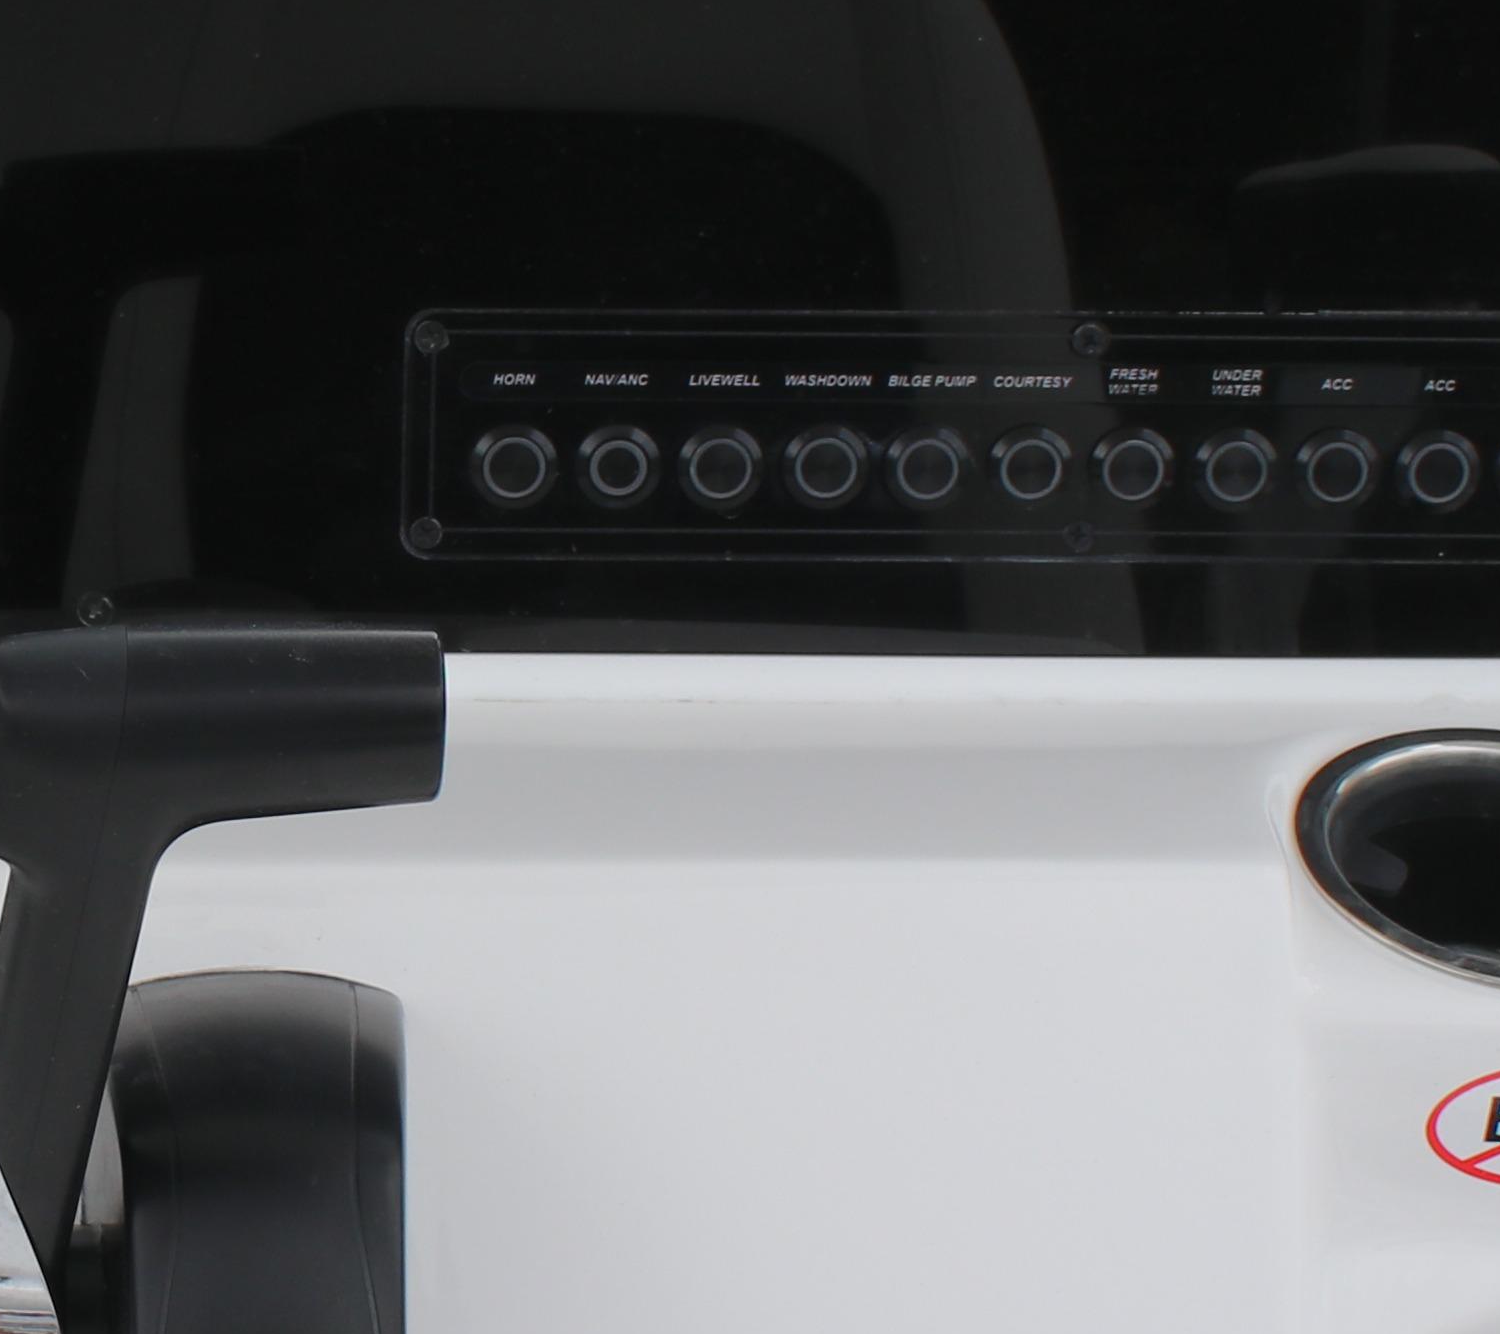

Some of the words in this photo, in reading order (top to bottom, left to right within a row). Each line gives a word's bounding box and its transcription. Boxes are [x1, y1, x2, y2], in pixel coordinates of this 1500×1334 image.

[493, 373, 536, 386] HORN
[1109, 368, 1159, 380] FRESH
[1212, 369, 1263, 381] UNDER
[688, 374, 761, 387] LIVEWELL
[784, 375, 872, 387] WASHDOWN
[887, 375, 932, 387] BILGE
[934, 375, 977, 387] PUMP
[993, 376, 1072, 388] COURTESY
[1321, 378, 1353, 390] ACC
[1424, 379, 1456, 391] ACC
[1107, 383, 1158, 395] WATER
[1210, 384, 1261, 396] WATER
